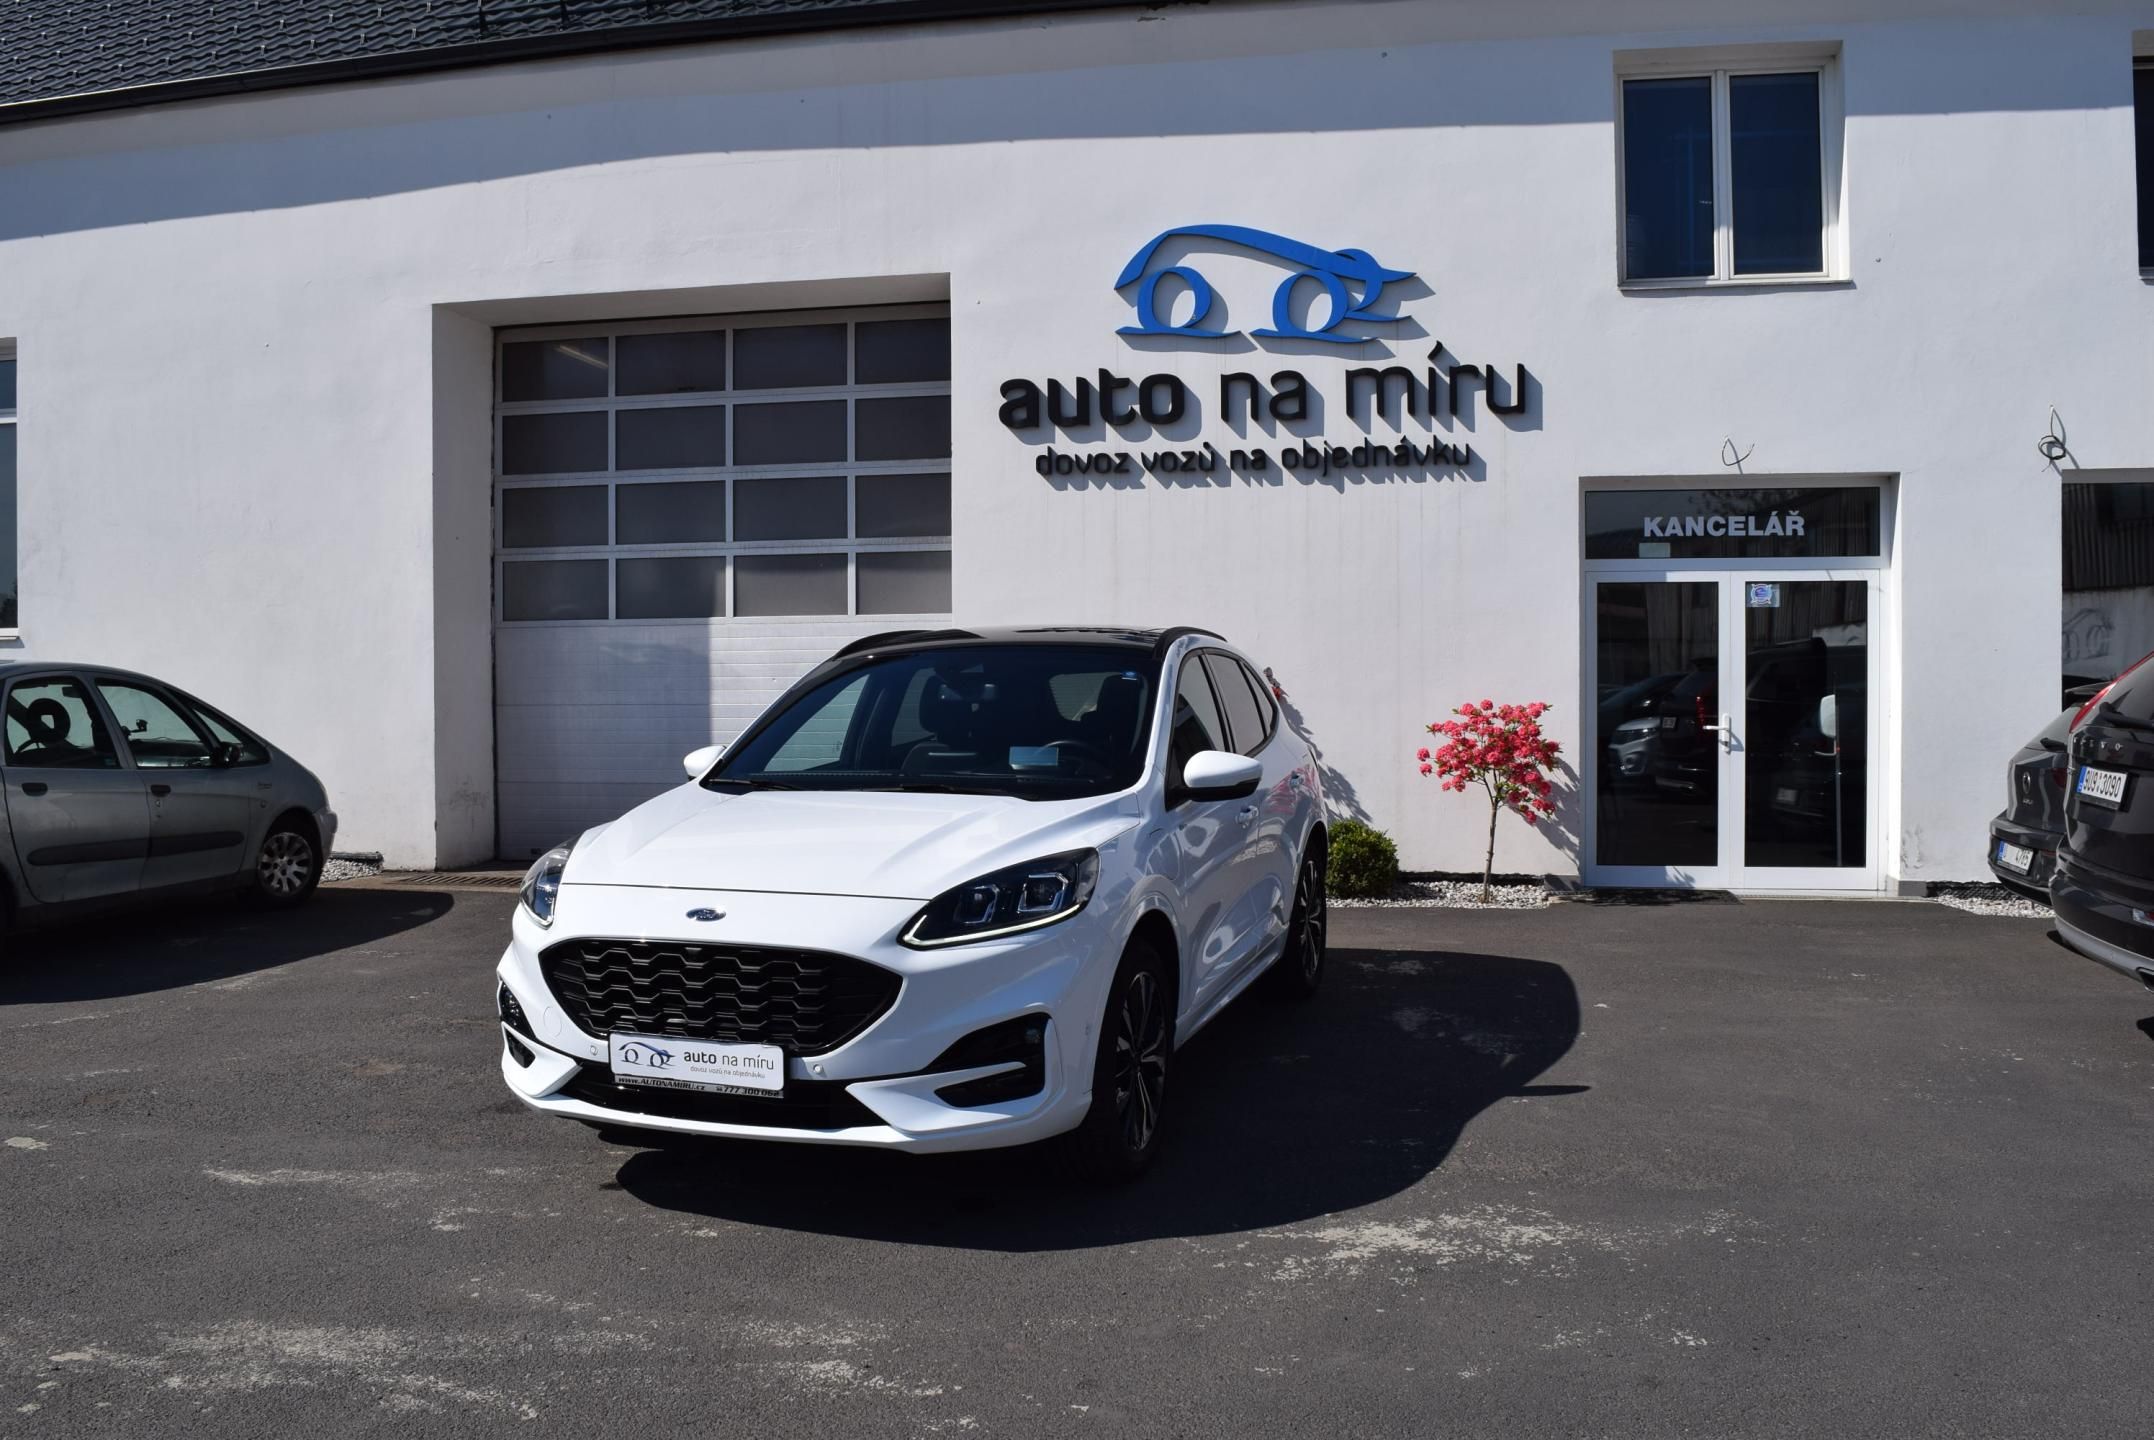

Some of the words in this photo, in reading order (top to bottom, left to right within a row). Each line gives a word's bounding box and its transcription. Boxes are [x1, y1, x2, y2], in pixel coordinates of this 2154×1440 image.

[999, 367, 1186, 429] auto
[1220, 369, 1308, 424] na
[1345, 340, 1526, 421] míru
[1035, 445, 1130, 477] dovoz
[1140, 441, 1216, 474] vozů
[1229, 444, 1267, 472] na
[1281, 435, 1471, 478] objednávku
[1643, 510, 1806, 538] KANCELÁŘ
[2100, 773, 2122, 798] 3090
[683, 1051, 717, 1064] auto
[722, 1055, 738, 1067] na
[743, 1054, 774, 1070] míru
[724, 1086, 741, 1094] 777
